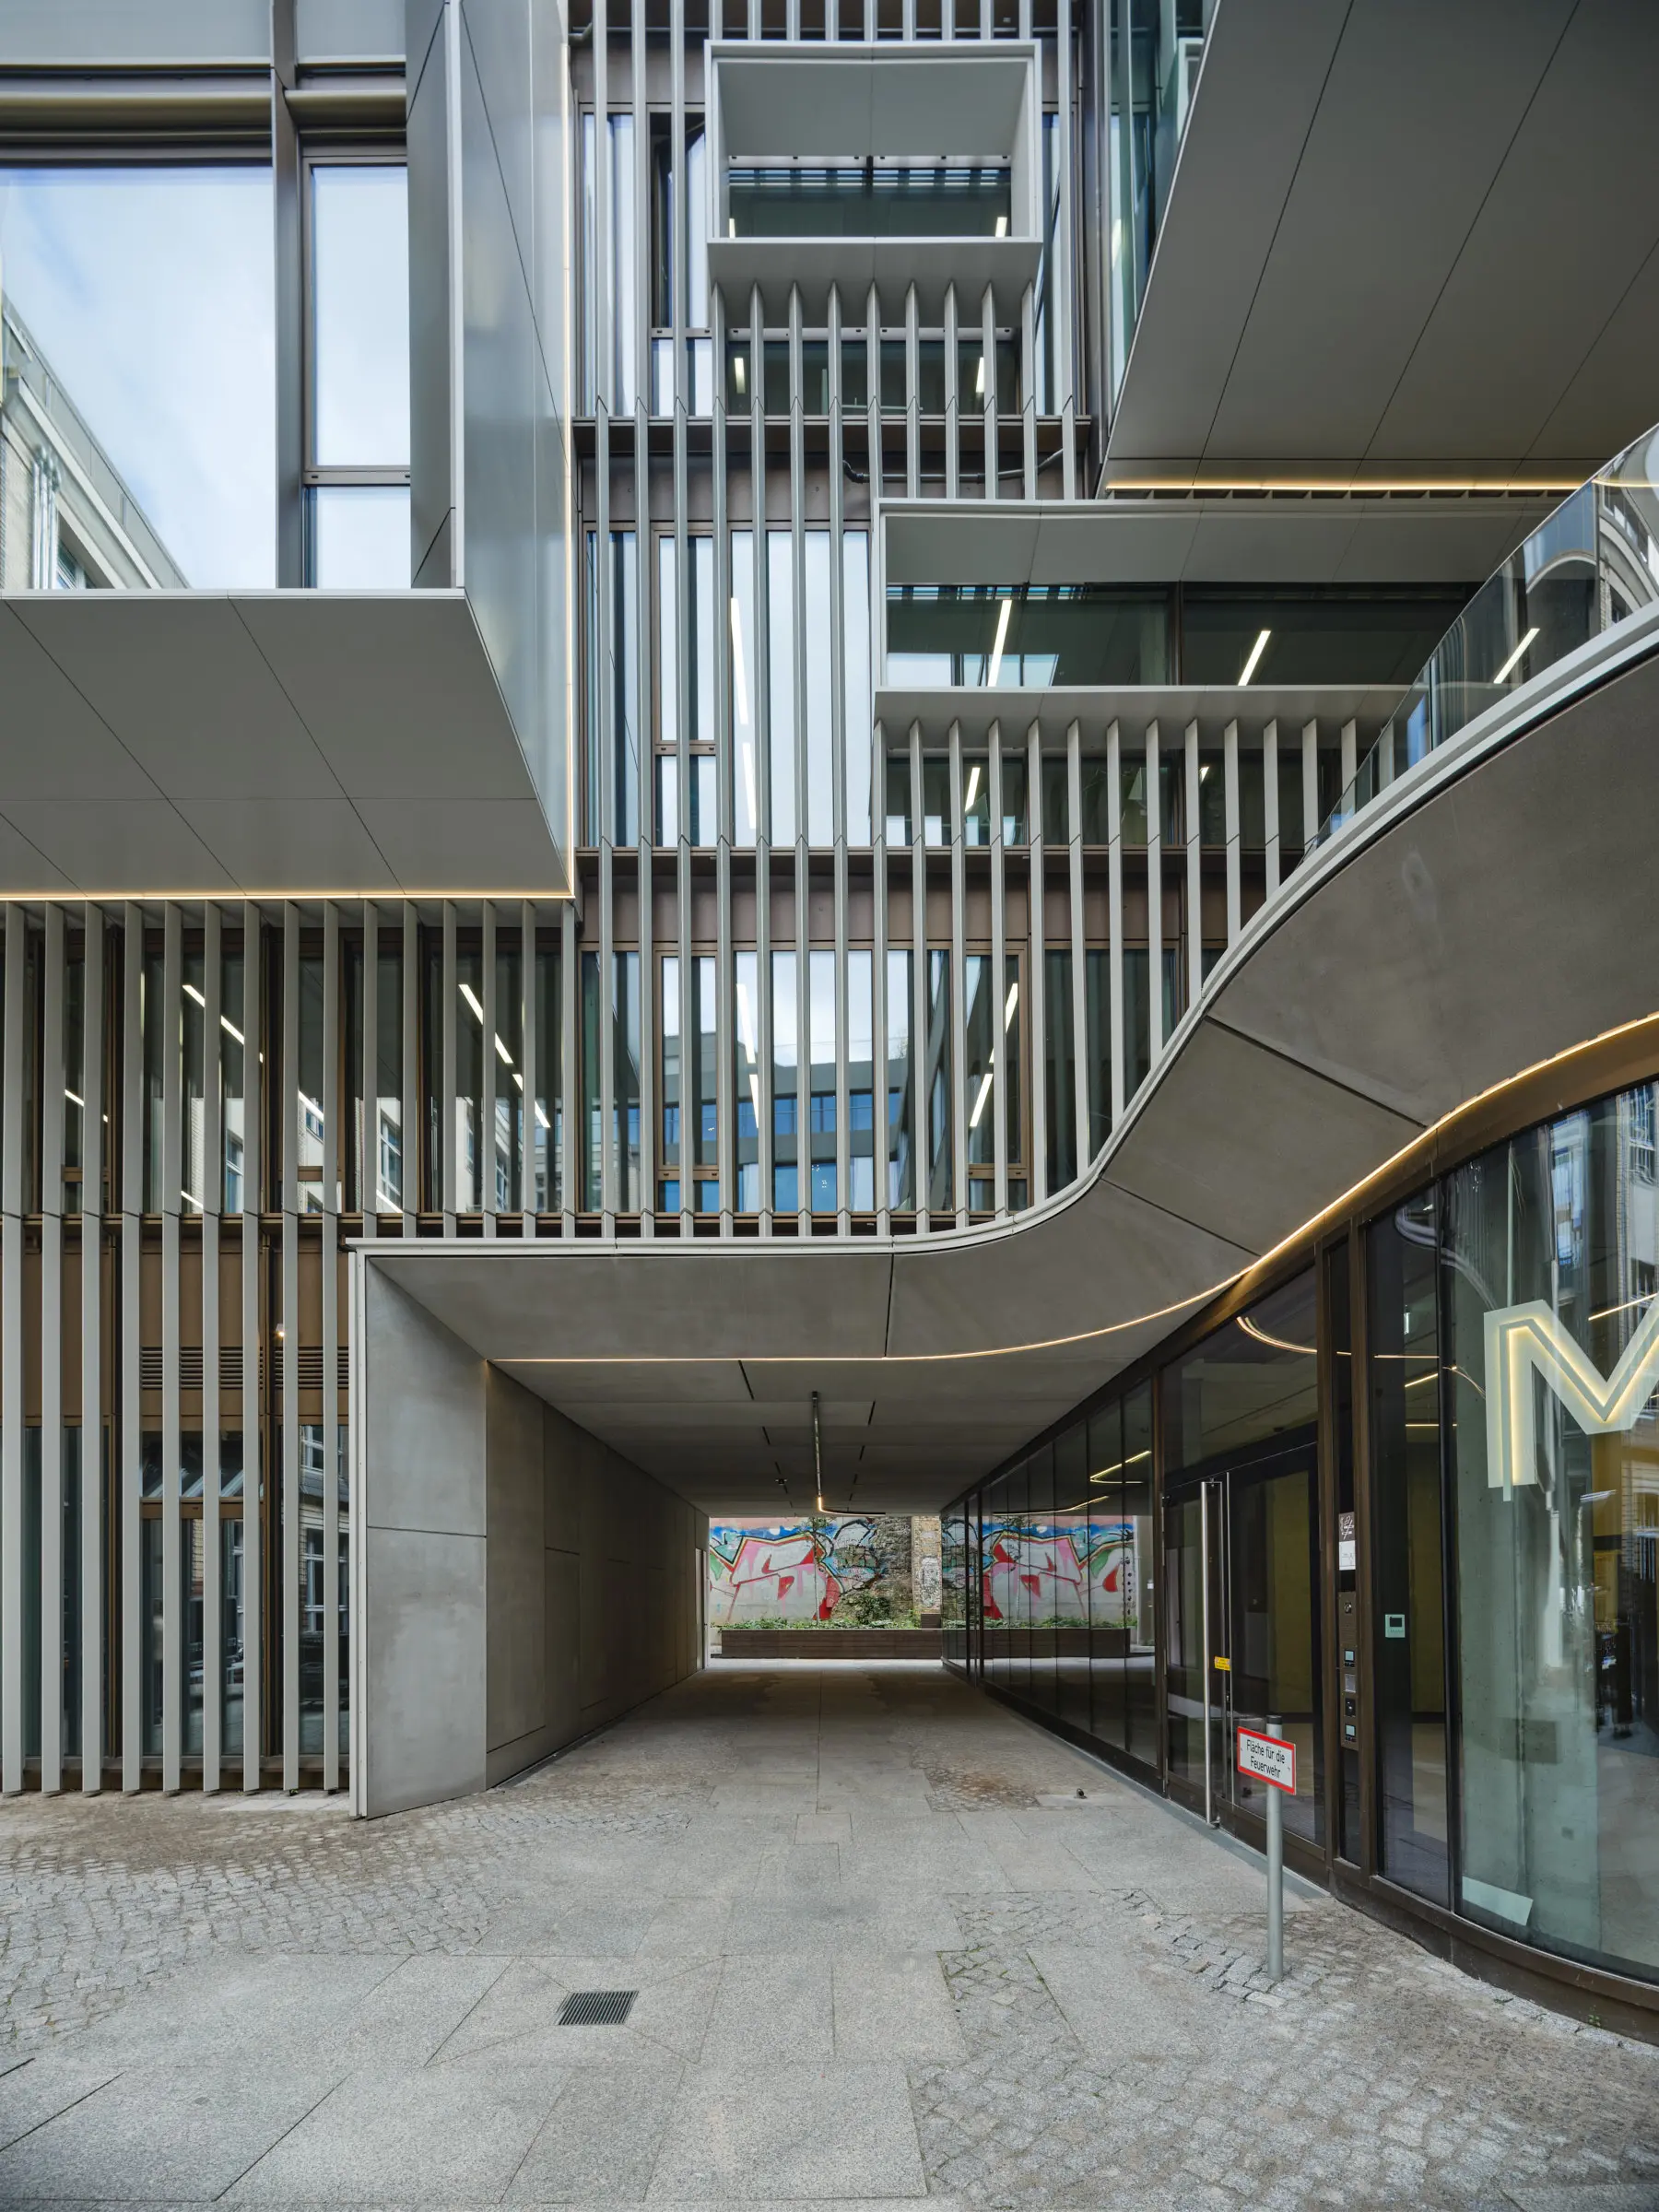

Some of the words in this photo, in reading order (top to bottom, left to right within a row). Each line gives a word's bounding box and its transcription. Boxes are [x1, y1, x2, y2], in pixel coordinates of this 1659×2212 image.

[1246, 1739, 1265, 1757] Fläche
[1265, 1746, 1275, 1760] für
[1276, 1749, 1286, 1764] die
[1250, 1756, 1281, 1779] Feuerwehr
